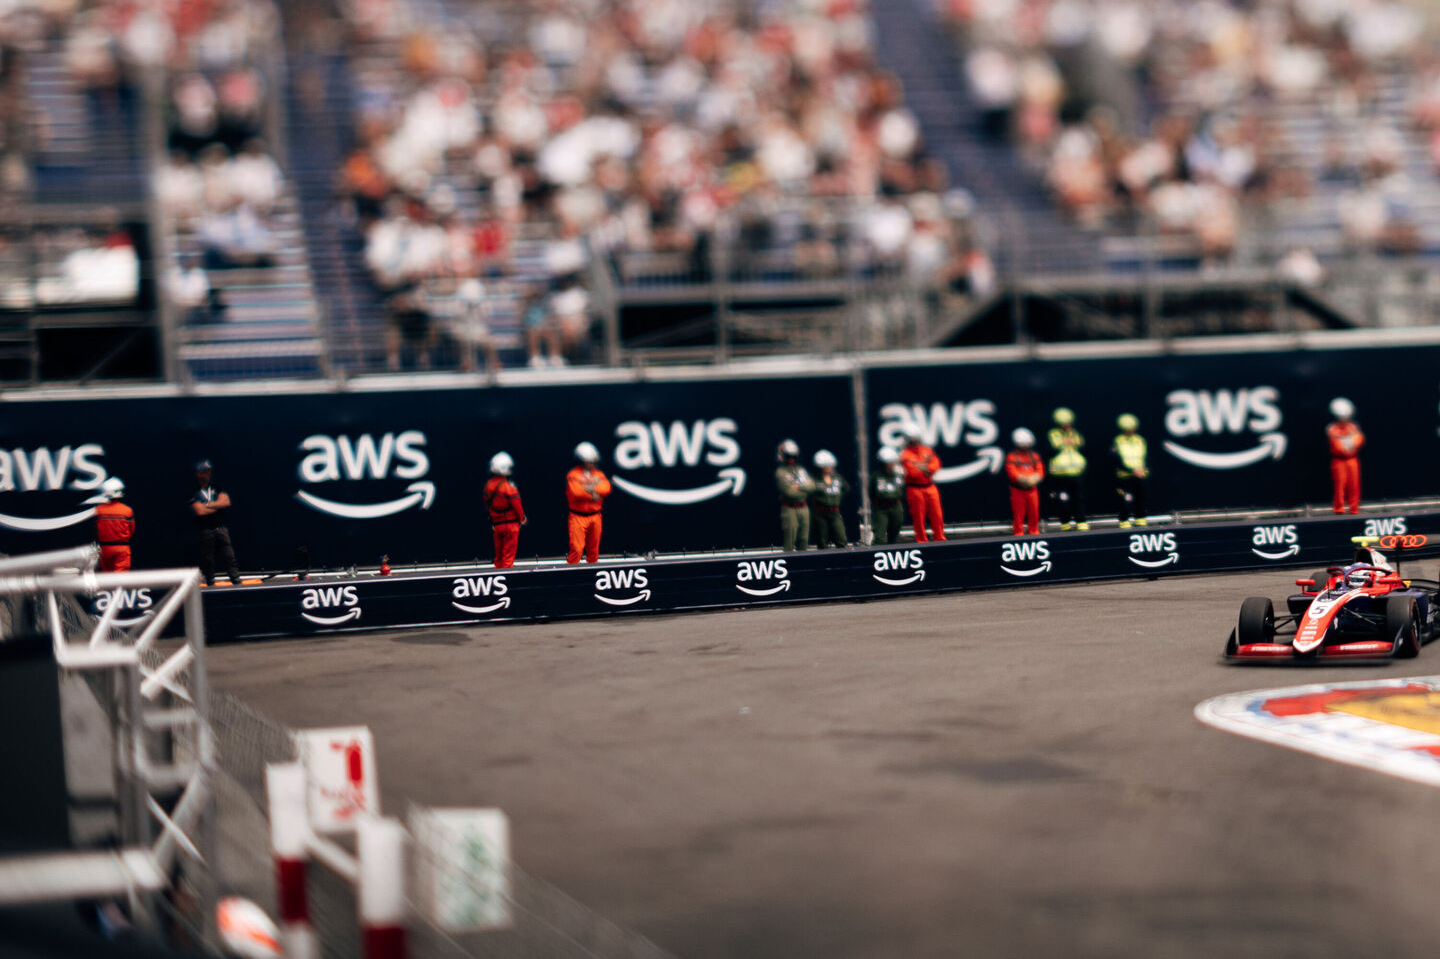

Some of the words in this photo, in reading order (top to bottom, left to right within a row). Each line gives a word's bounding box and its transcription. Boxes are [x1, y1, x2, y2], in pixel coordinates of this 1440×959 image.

[1165, 386, 1283, 434] aws
[879, 399, 998, 447] aws
[615, 418, 740, 468] aws
[300, 431, 430, 483] aws
[1252, 524, 1298, 545] aws
[1364, 516, 1407, 536] aws
[1001, 541, 1049, 562] aws
[1129, 532, 1176, 553] aws
[736, 559, 789, 581] aws
[873, 549, 923, 571] aws
[452, 575, 508, 598] aws
[594, 568, 648, 590] aws
[301, 585, 358, 608] aws
[1312, 605, 1328, 615] 5
